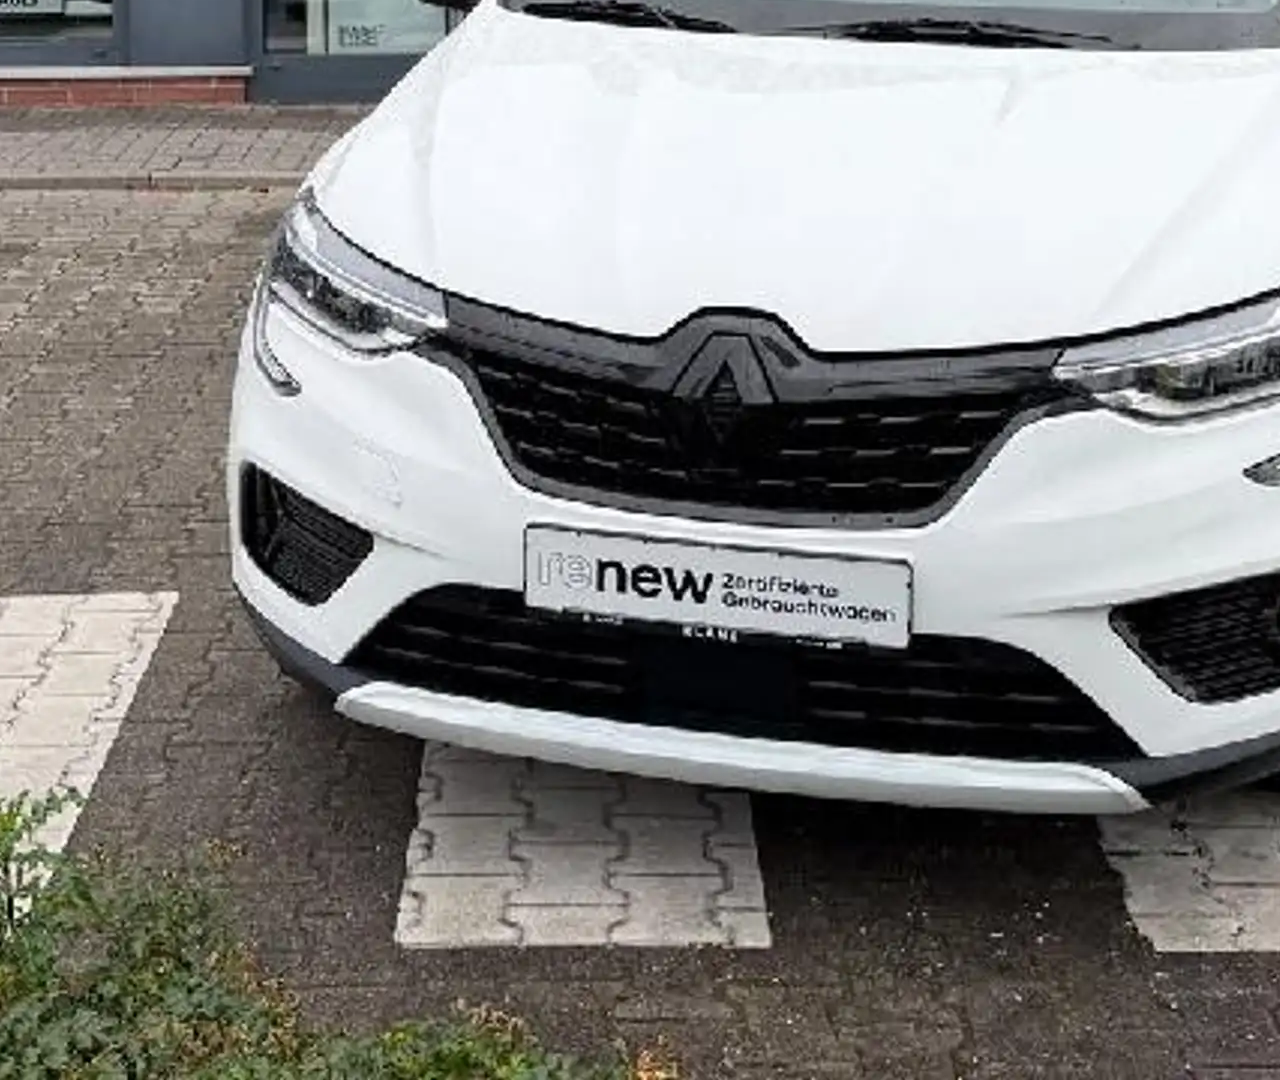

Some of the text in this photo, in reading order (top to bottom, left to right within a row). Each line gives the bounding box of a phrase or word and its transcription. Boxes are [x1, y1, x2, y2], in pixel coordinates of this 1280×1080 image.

[537, 551, 713, 605] renew
[721, 573, 840, 598] Zertifizierte
[721, 591, 897, 625] Gebrauchtwagen
